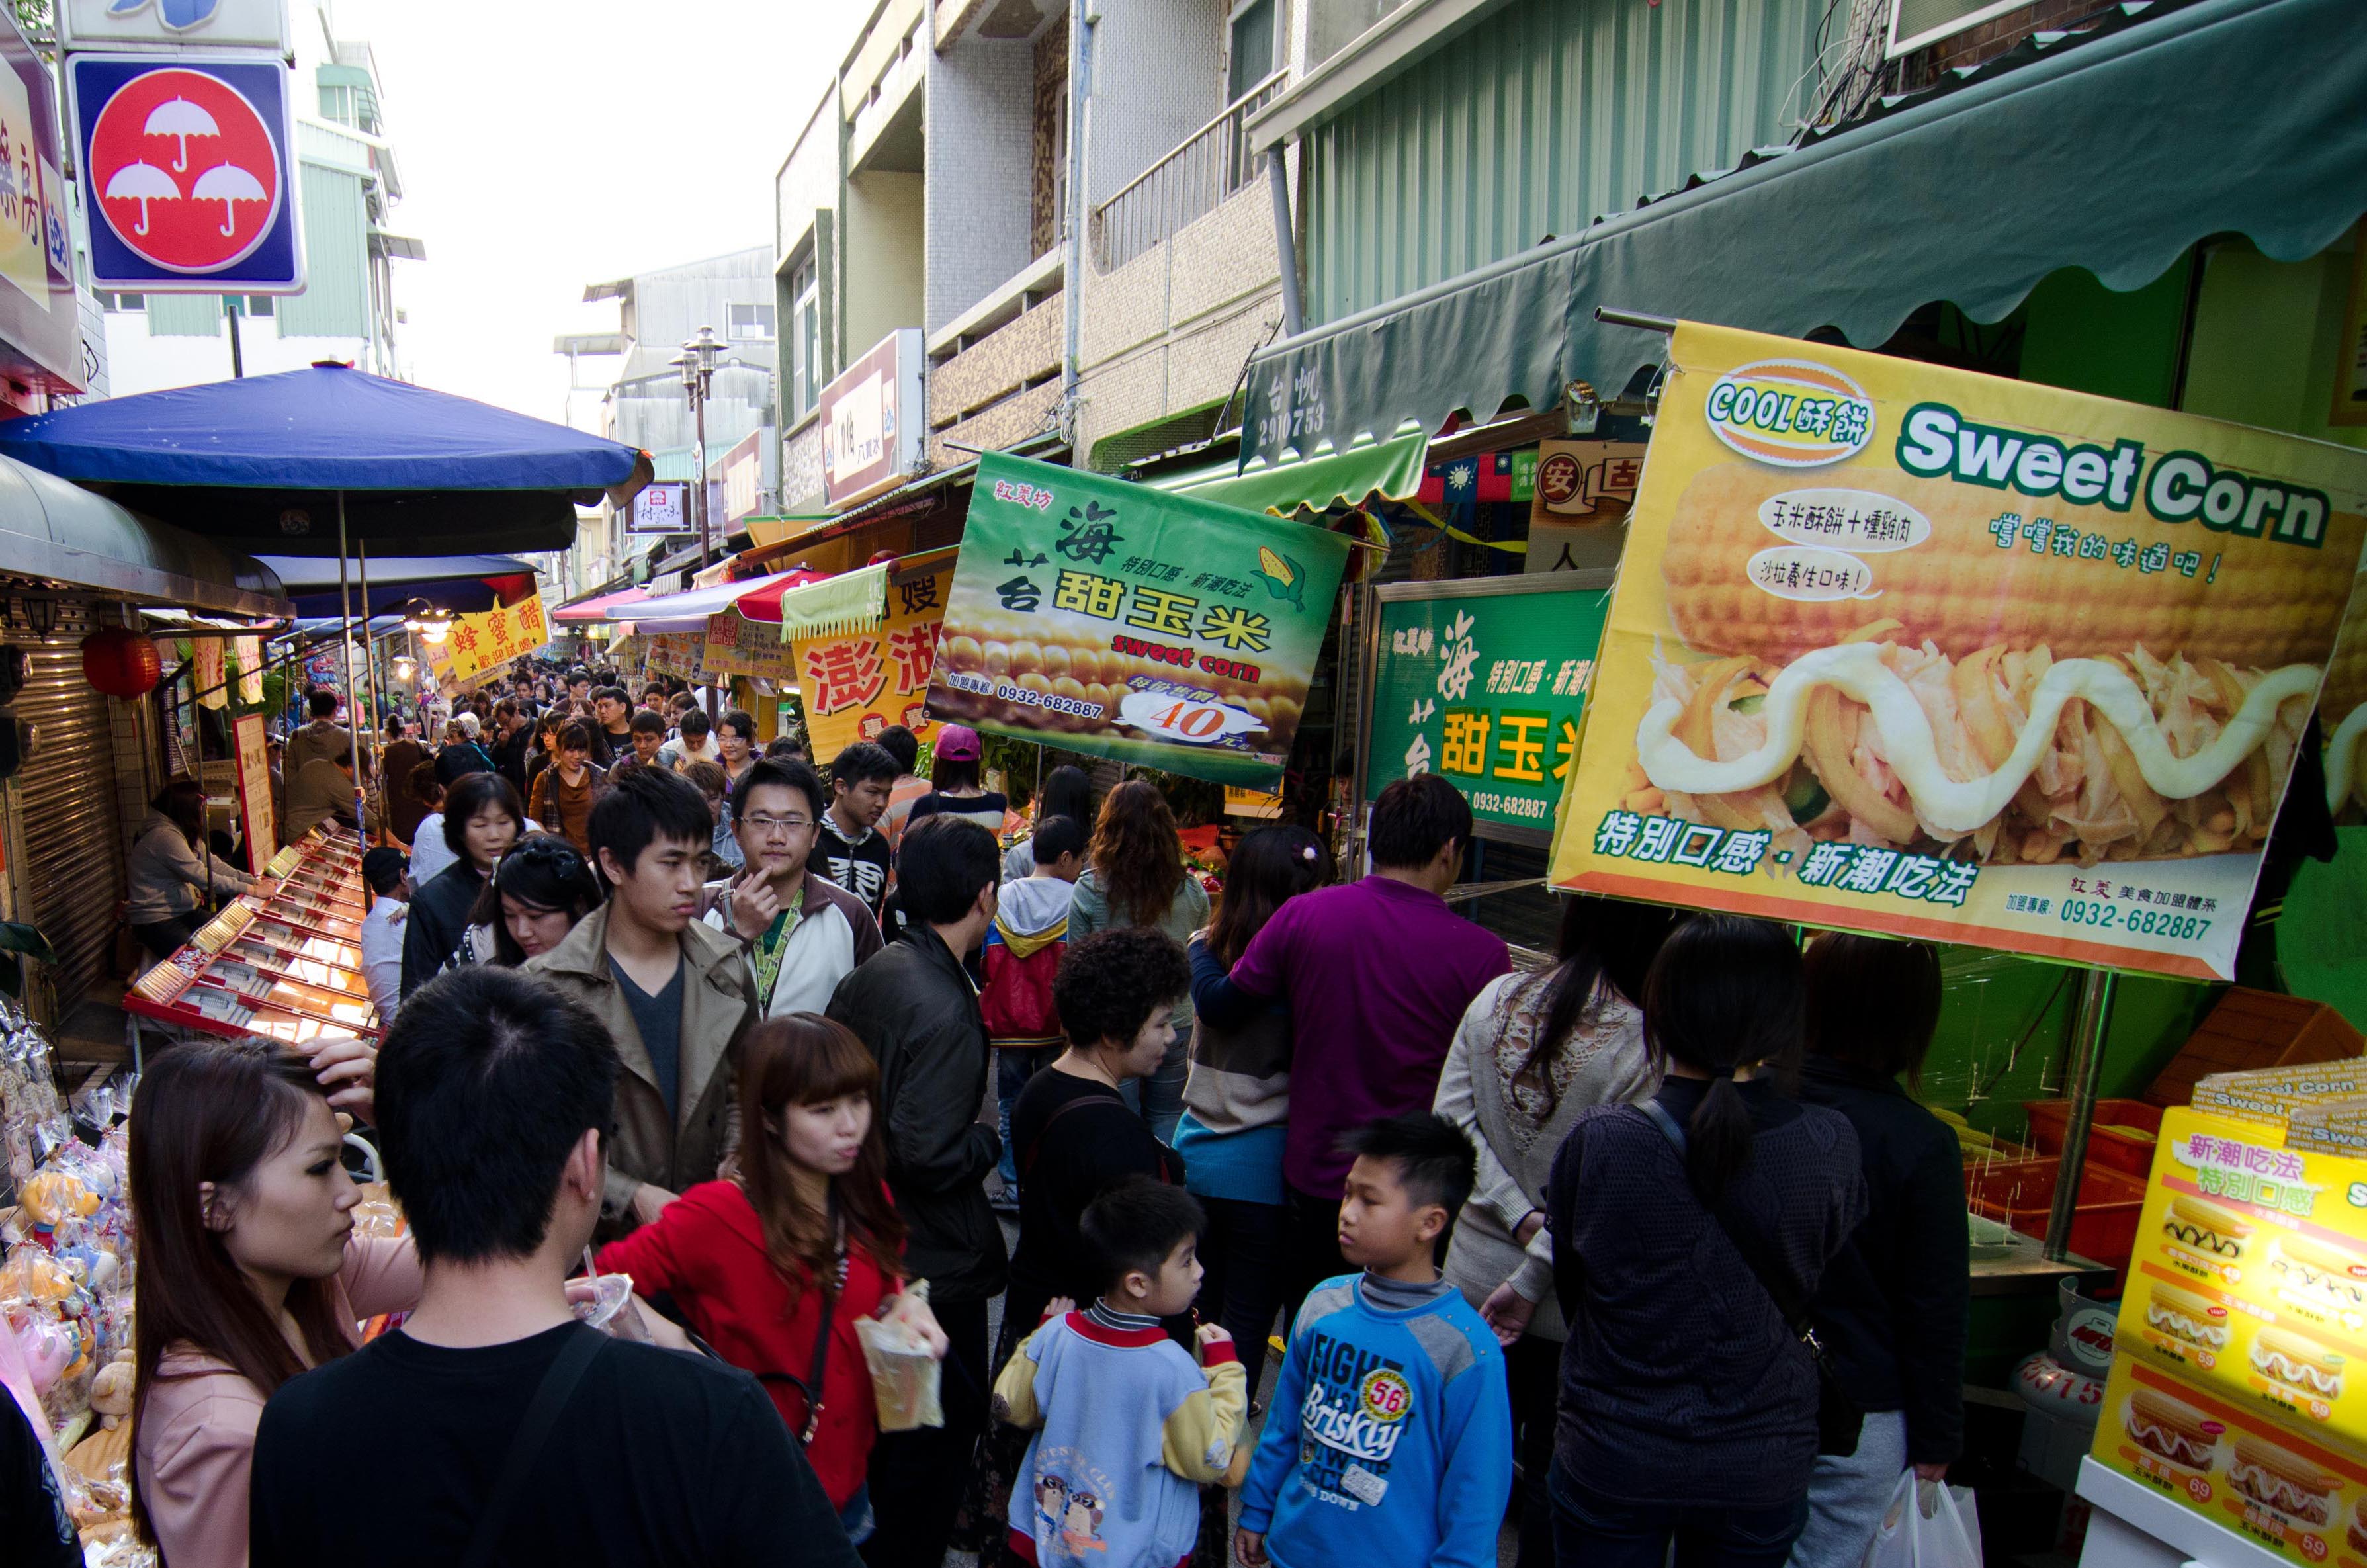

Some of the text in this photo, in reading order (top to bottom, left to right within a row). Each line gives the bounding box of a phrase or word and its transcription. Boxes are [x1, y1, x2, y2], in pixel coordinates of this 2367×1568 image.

[1258, 402, 1324, 447] 2910753
[1709, 382, 1868, 445] COOL 酥餅
[1545, 462, 1574, 494] 安
[1897, 404, 2329, 547] Sweet Corn
[454, 599, 540, 656] 蜂蜜醋
[1052, 568, 1272, 653] 甜玉米
[478, 637, 533, 670] 歡迎試喝
[1111, 634, 1261, 683] sweet corn
[998, 685, 1104, 720] 0932-682887
[1150, 701, 1225, 737] 40
[1473, 792, 1547, 819] 0932-682887
[2061, 898, 2212, 941] 0932-682887
[2214, 1092, 2284, 1116] Sweet
[2298, 1081, 2356, 1094] Corn
[2187, 1134, 2302, 1181] 新潮吃法
[2198, 1166, 2313, 1217] 特別口感
[1370, 1380, 1404, 1414] 56
[1303, 1383, 1403, 1461] Briskly
[2189, 1477, 2210, 1497] 69
[2302, 1533, 2325, 1556] 59
